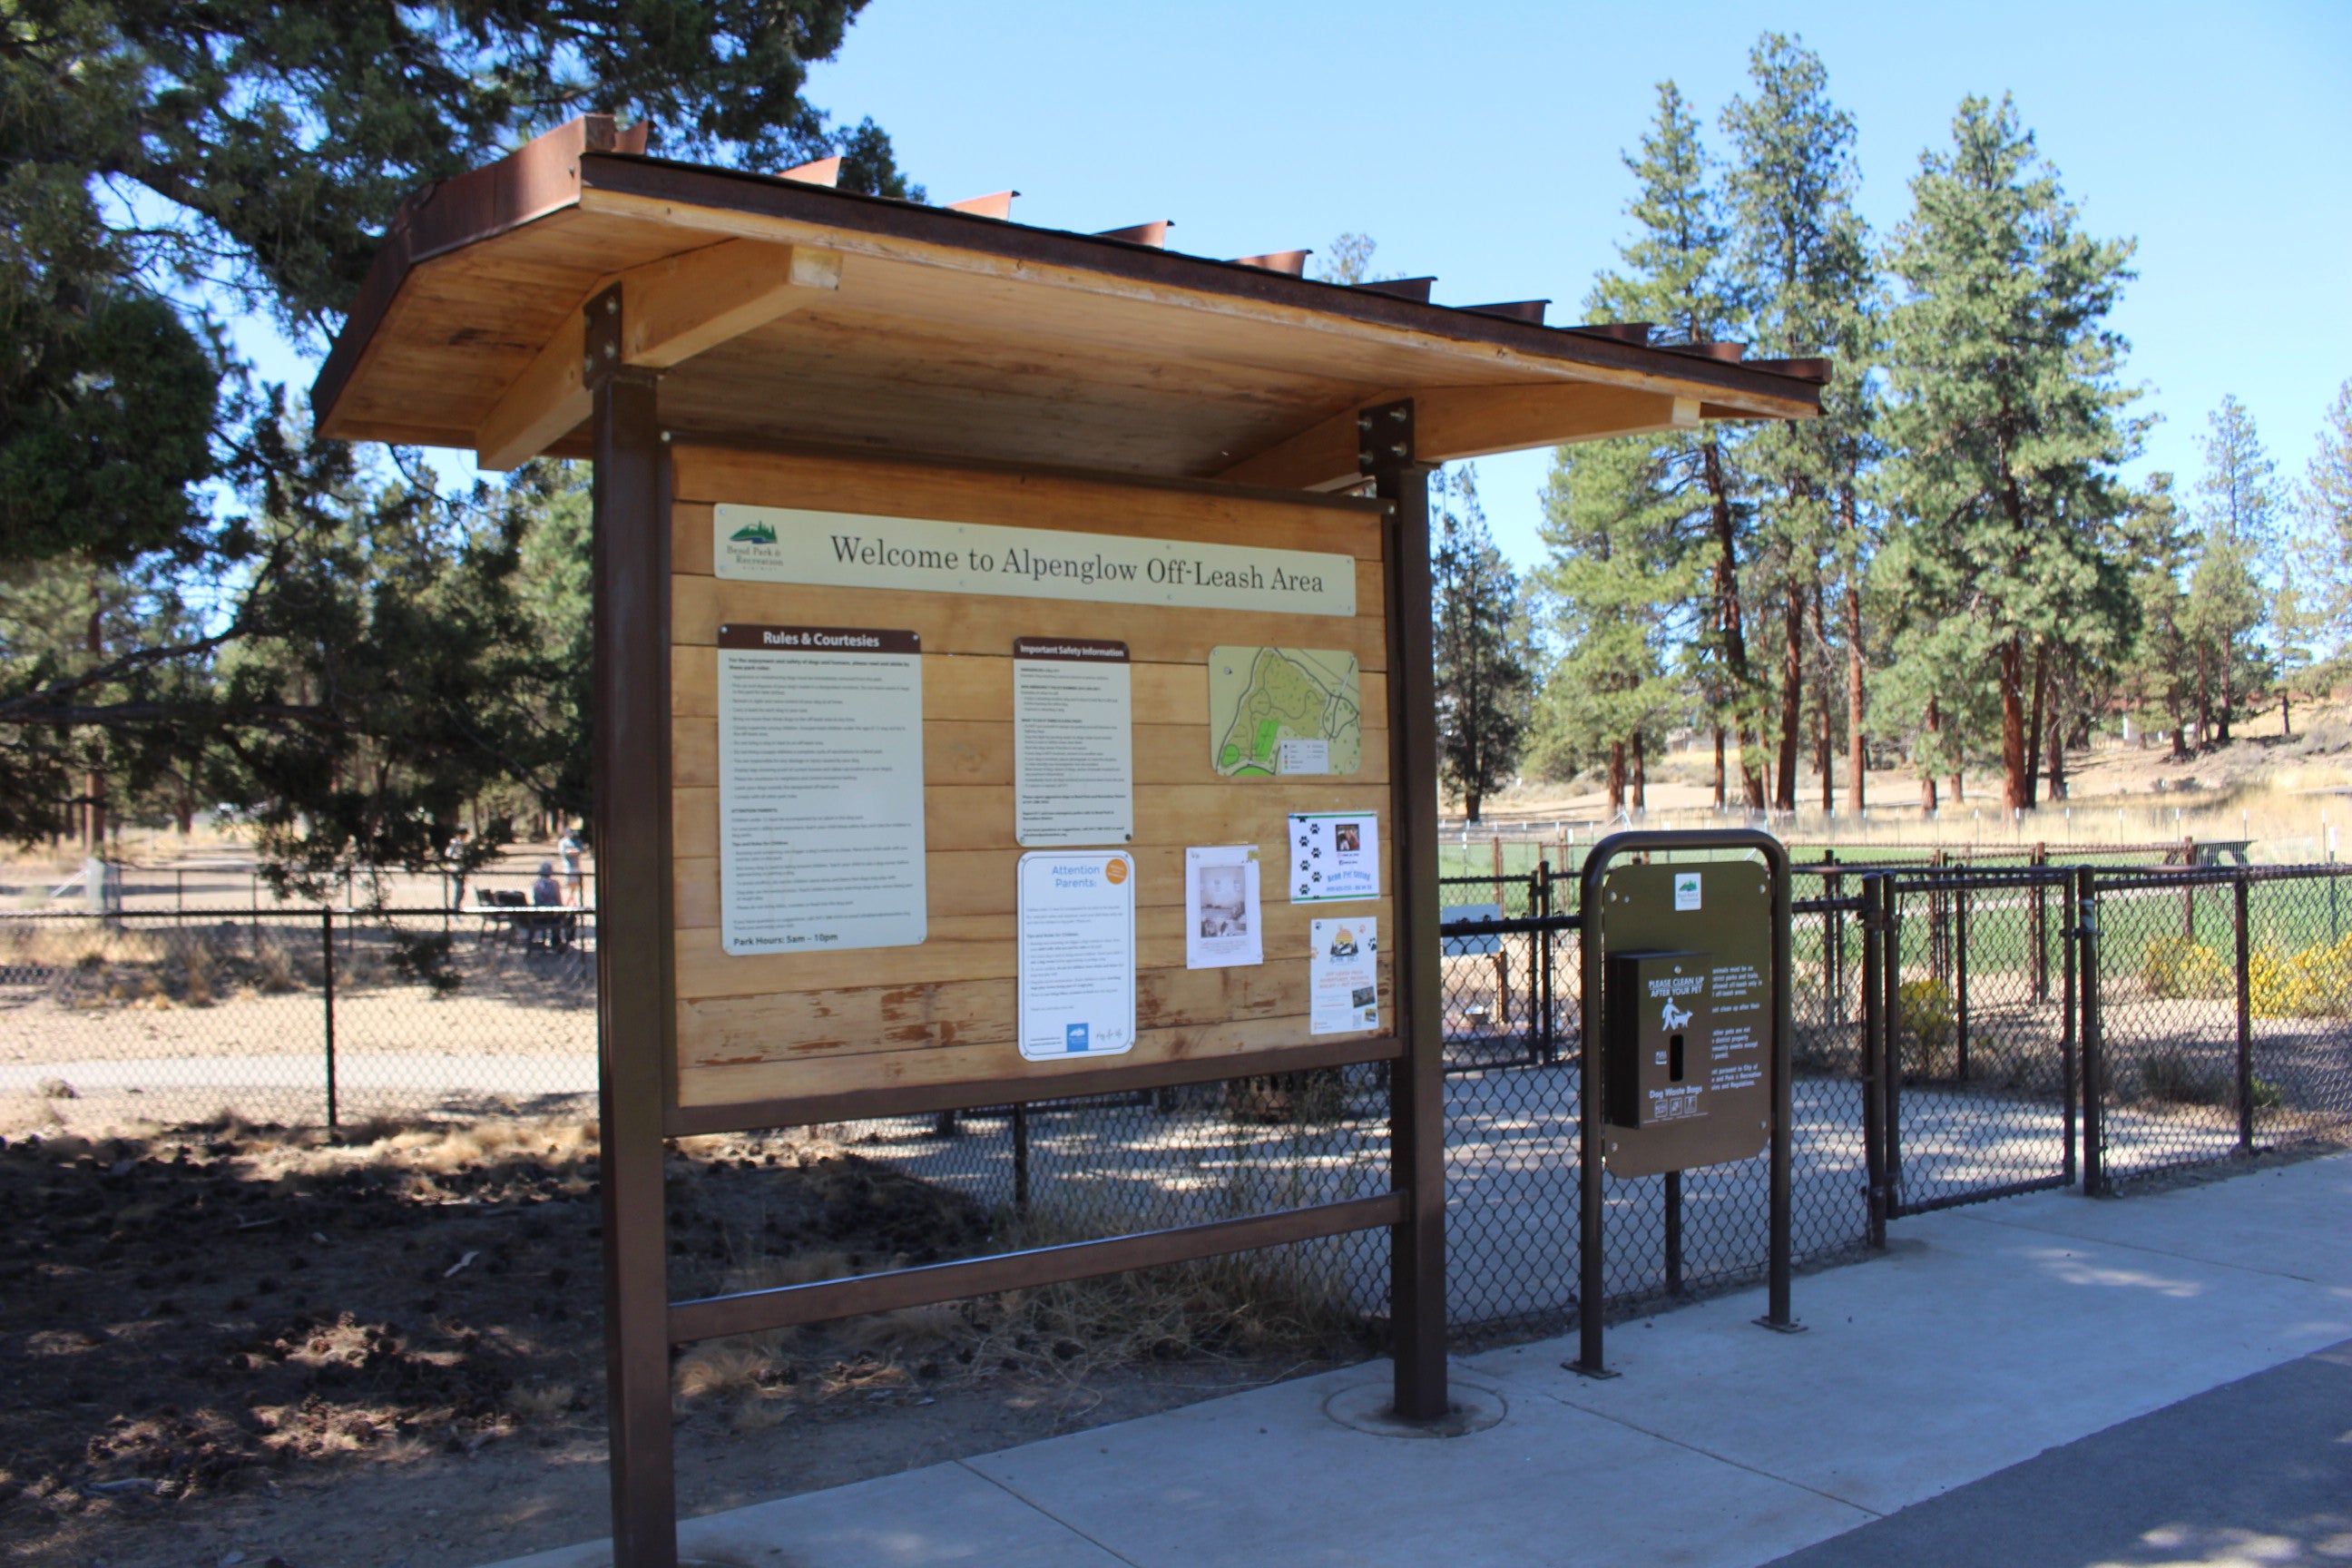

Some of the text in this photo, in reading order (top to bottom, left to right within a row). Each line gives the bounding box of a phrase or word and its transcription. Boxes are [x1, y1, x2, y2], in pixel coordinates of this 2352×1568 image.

[752, 546, 771, 556] Park
[735, 554, 784, 567] Recreation
[830, 534, 1324, 593] Welcome to Alpenglow Off-Leash Area
[763, 632, 880, 647] Rules & Courtesies
[1020, 644, 1124, 657] Important Safety Information
[1052, 865, 1101, 875] Attention
[1055, 878, 1097, 888] Parents:
[733, 937, 753, 946] Park
[755, 936, 786, 946] Hours:
[786, 934, 806, 944] 5am
[814, 933, 838, 944] 10pm
[1648, 975, 1705, 988] PLEASE CLEAN UP
[1651, 985, 1702, 997] AFTER YOUR PET
[1649, 1085, 1703, 1099] Dog Waste Bags
